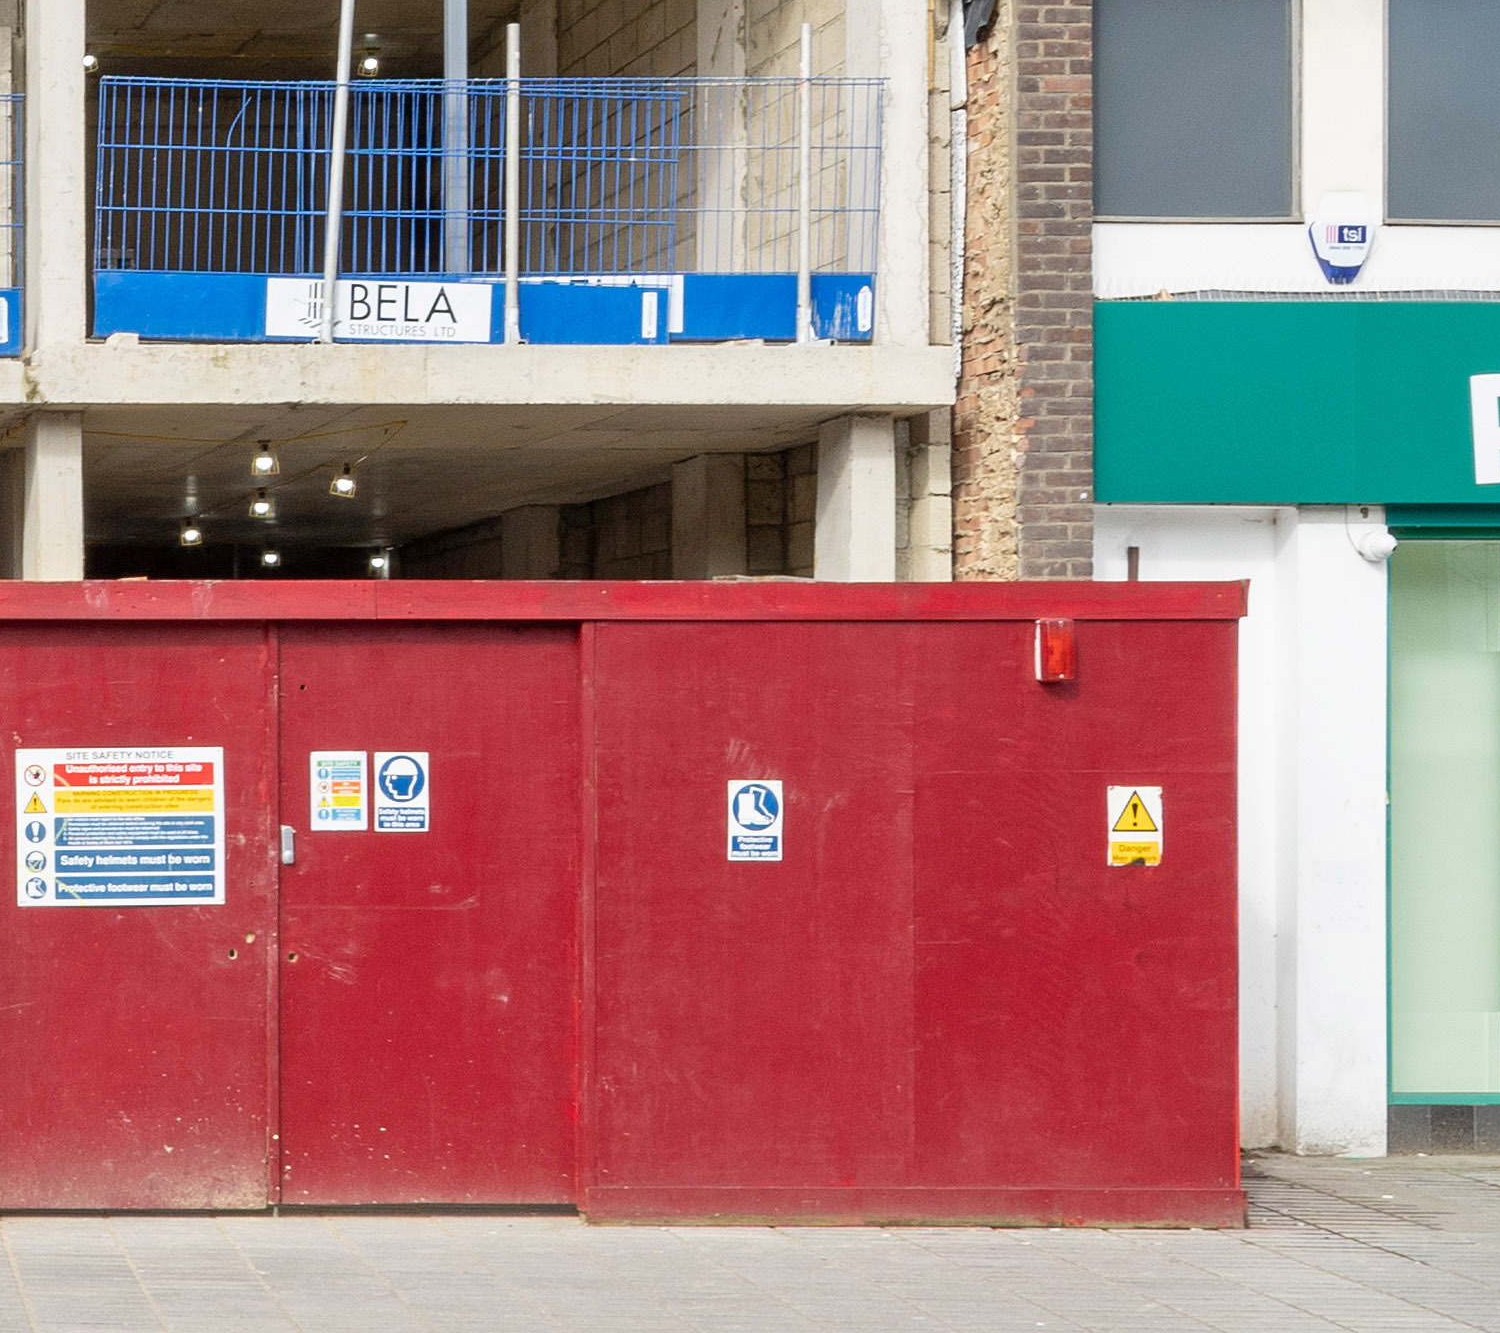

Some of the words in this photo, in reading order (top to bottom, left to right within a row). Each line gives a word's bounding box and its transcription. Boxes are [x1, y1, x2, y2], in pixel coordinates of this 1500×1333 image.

[350, 284, 456, 323] BELA
[66, 752, 88, 760] SITE
[1119, 845, 1151, 854] Danger
[61, 855, 94, 867] Safety
[96, 855, 138, 865] helmets
[140, 855, 166, 864] must
[168, 854, 182, 864] be
[184, 856, 210, 864] worn
